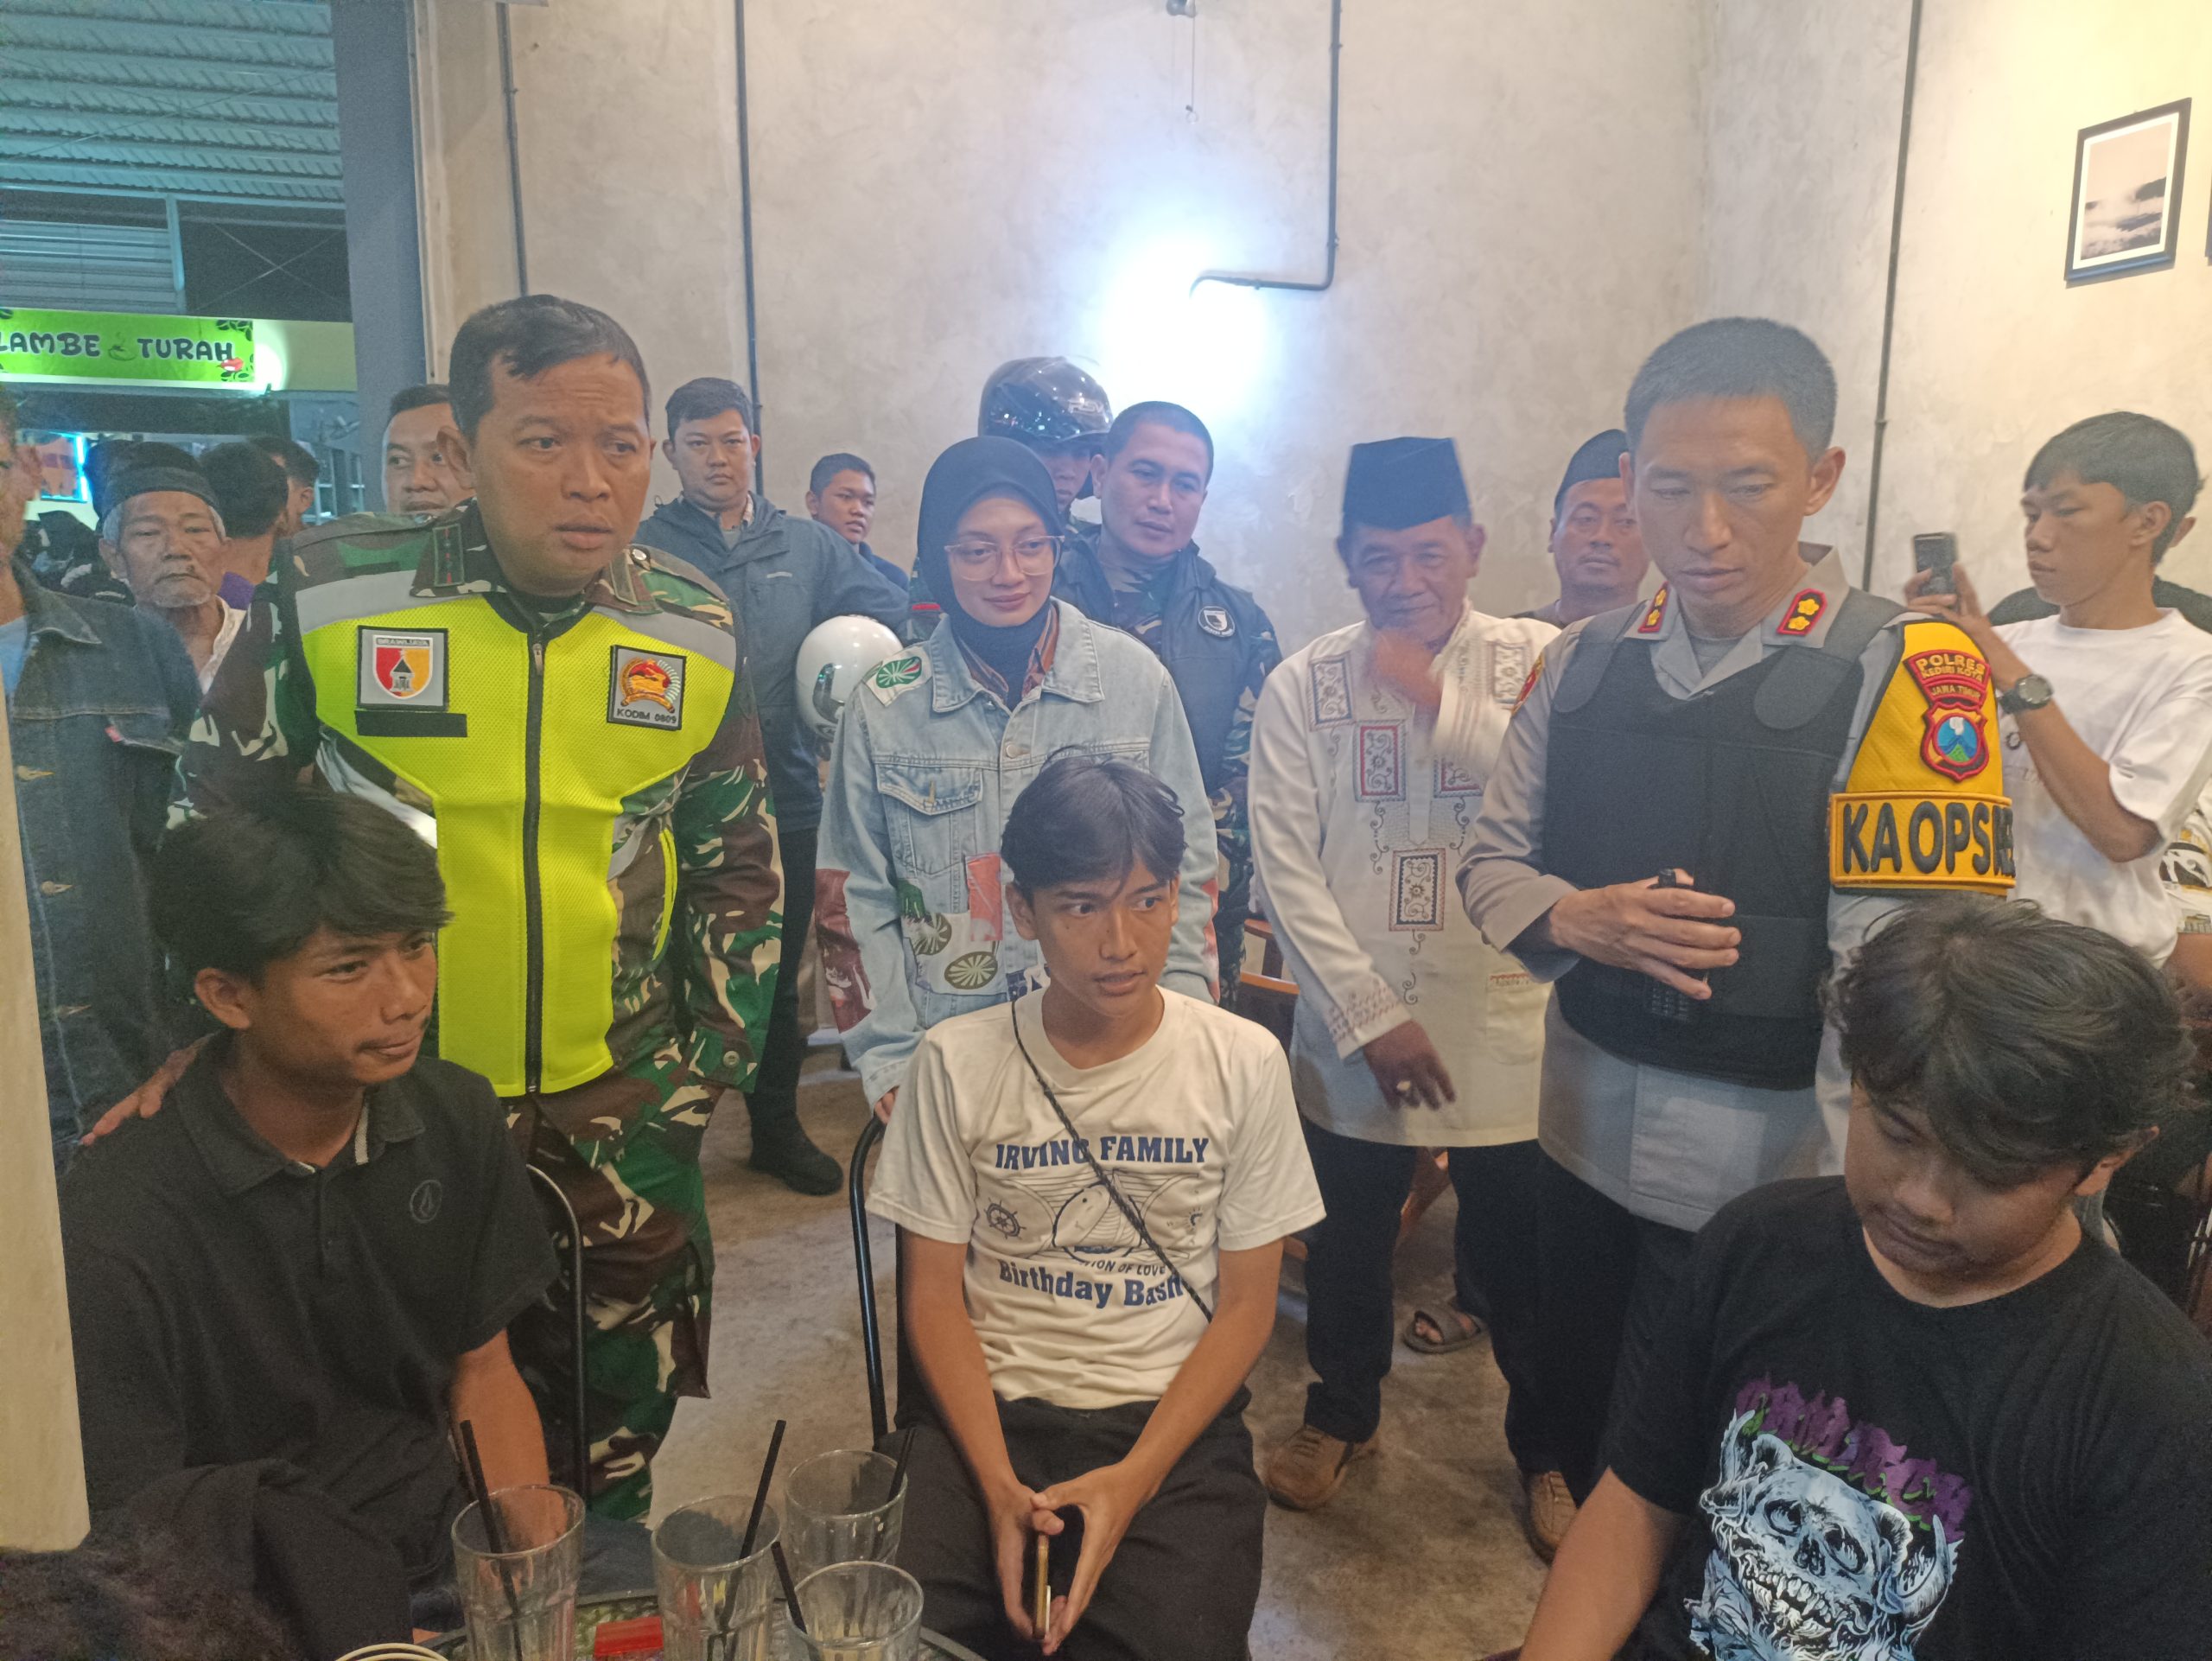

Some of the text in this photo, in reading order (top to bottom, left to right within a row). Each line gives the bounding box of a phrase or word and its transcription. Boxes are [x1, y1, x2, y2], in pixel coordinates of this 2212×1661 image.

[137, 338, 232, 361] TURAH
[1916, 653, 1986, 674] POLRES
[1921, 665, 1983, 683] KEDIRI KOTA
[1931, 684, 1955, 696] JAWA
[616, 708, 650, 720] KODIM
[995, 1136, 1209, 1170] IRVING FAMILY
[1118, 1263, 1134, 1274] OF
[1136, 1264, 1166, 1276] LOVE
[998, 1258, 1184, 1309] Birthday Bash
